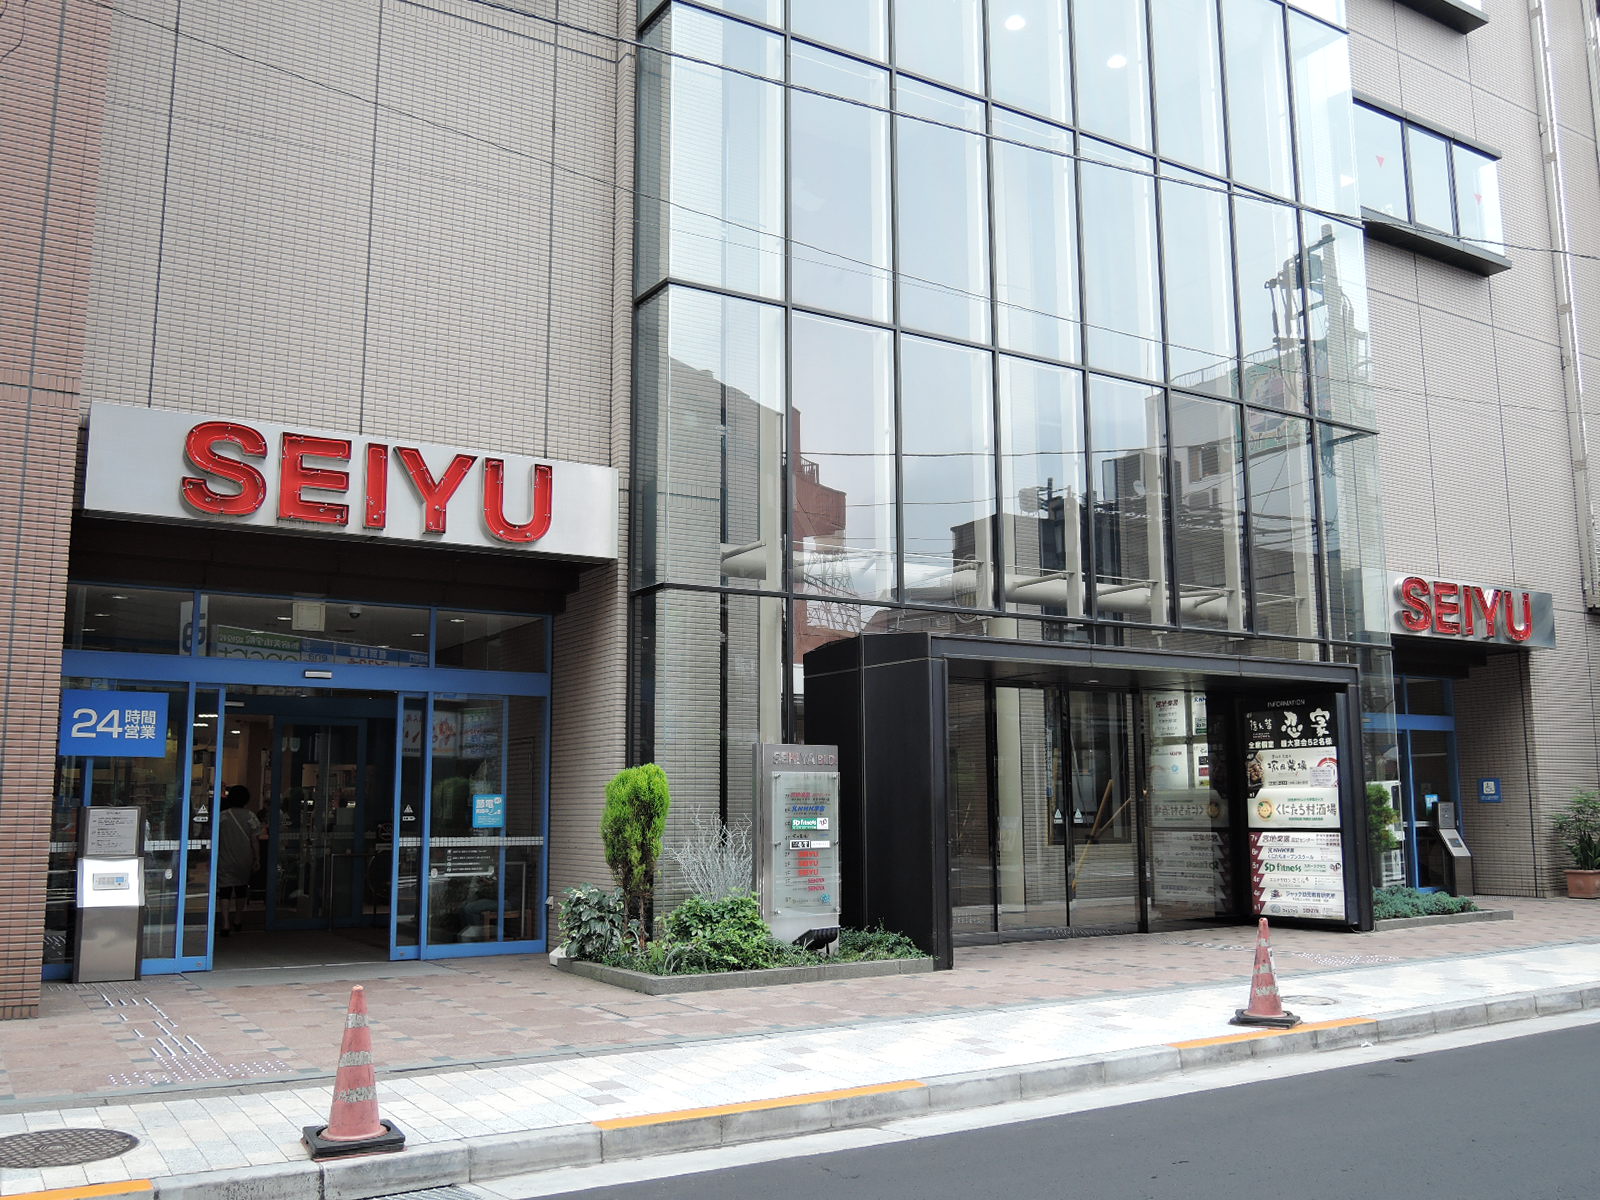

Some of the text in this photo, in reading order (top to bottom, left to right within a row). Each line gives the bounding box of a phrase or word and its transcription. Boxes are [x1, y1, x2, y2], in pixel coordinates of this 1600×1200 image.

[181, 420, 554, 544] SEIYU
[1398, 576, 1533, 642] SEIYU
[1267, 698, 1305, 708] INFORMATION
[71, 708, 156, 739] 24 時間
[124, 725, 155, 740] 営業
[1276, 802, 1337, 816] くにたち村酒場
[1264, 862, 1276, 872] SD
[1277, 863, 1302, 872] fitness
